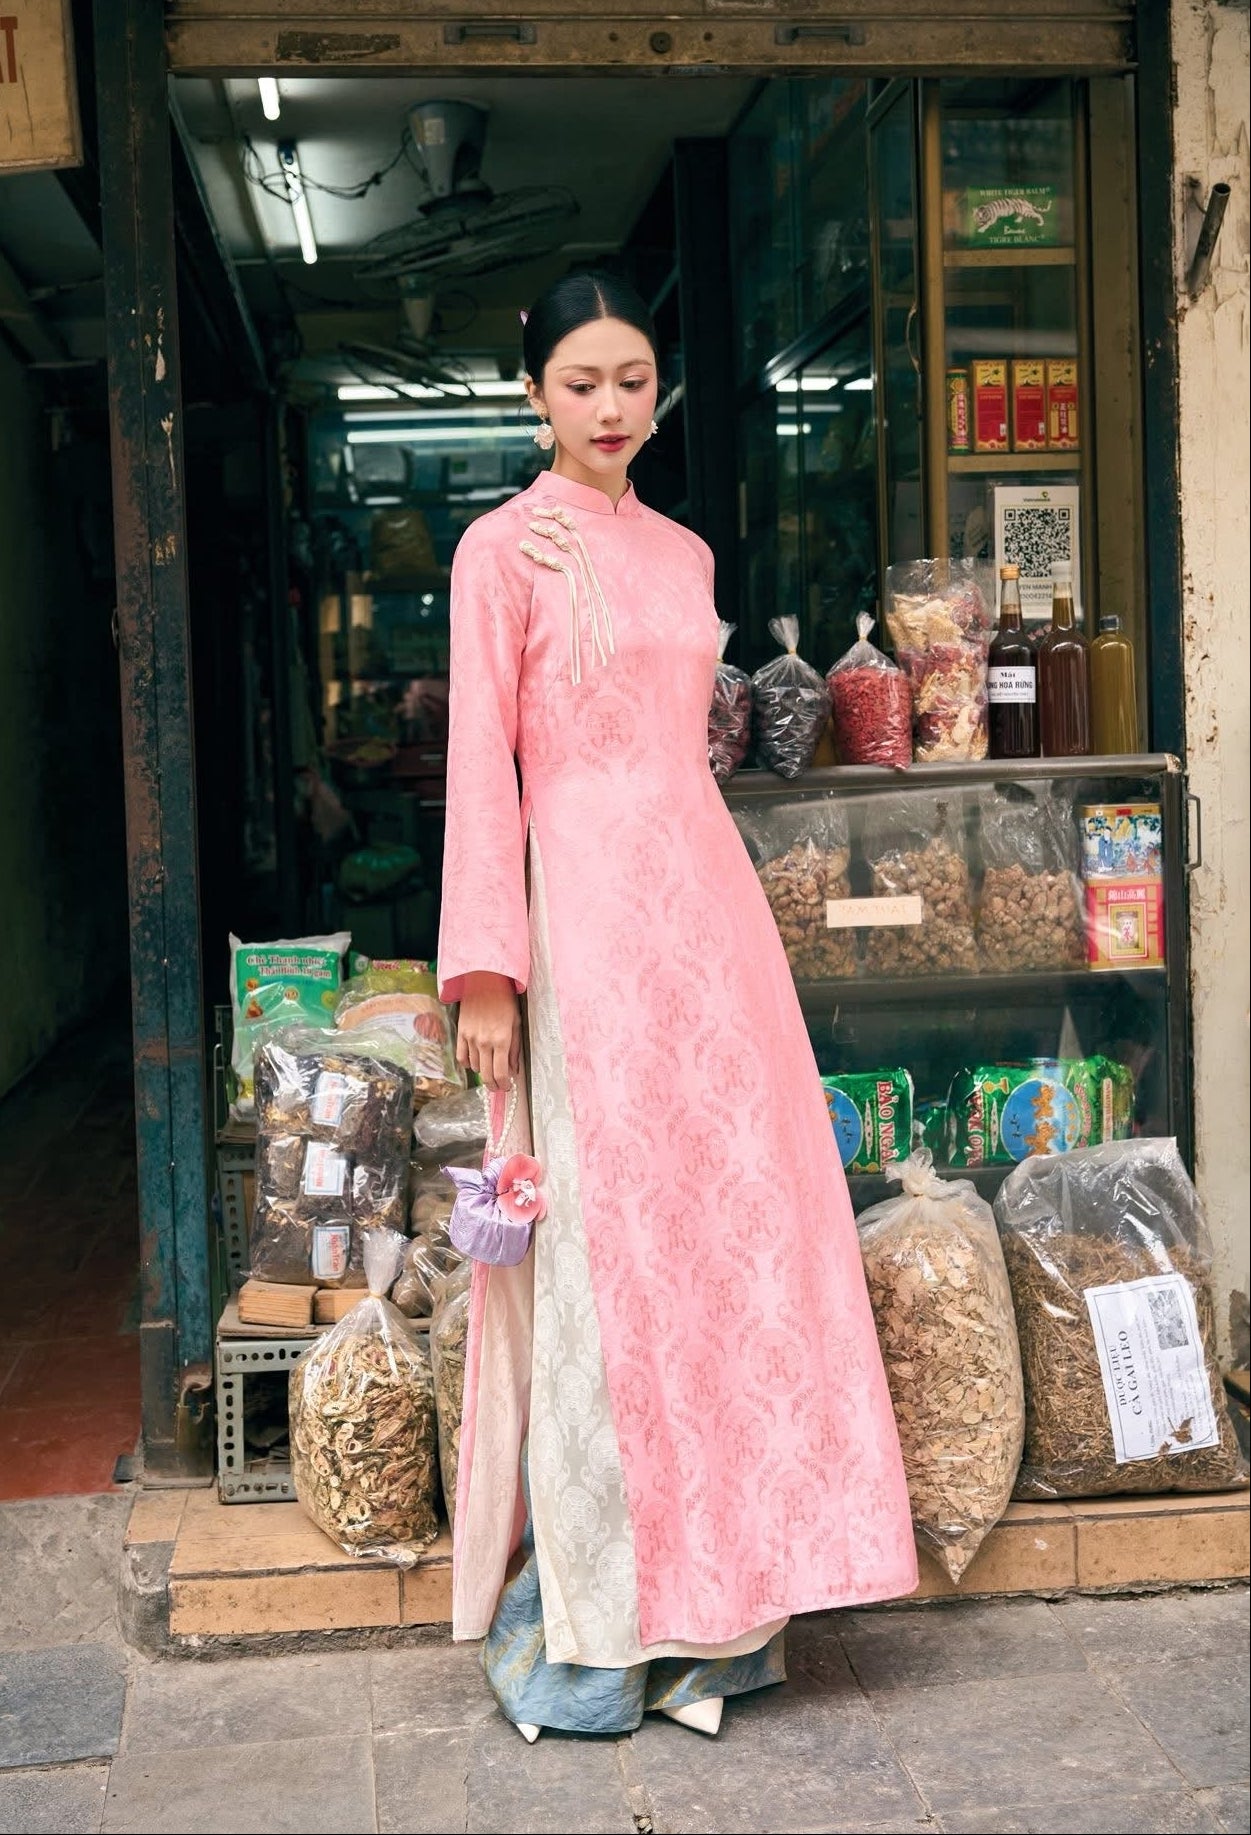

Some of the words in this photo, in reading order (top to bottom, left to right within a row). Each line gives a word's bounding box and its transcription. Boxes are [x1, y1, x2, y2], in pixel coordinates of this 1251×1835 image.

[0, 16, 18, 83] T
[999, 681, 1014, 689] HOA
[877, 1081, 899, 1119] BẢO
[1118, 1331, 1132, 1360] LEO
[1124, 1364, 1138, 1391] GAI
[1128, 1394, 1143, 1416] CÀ
